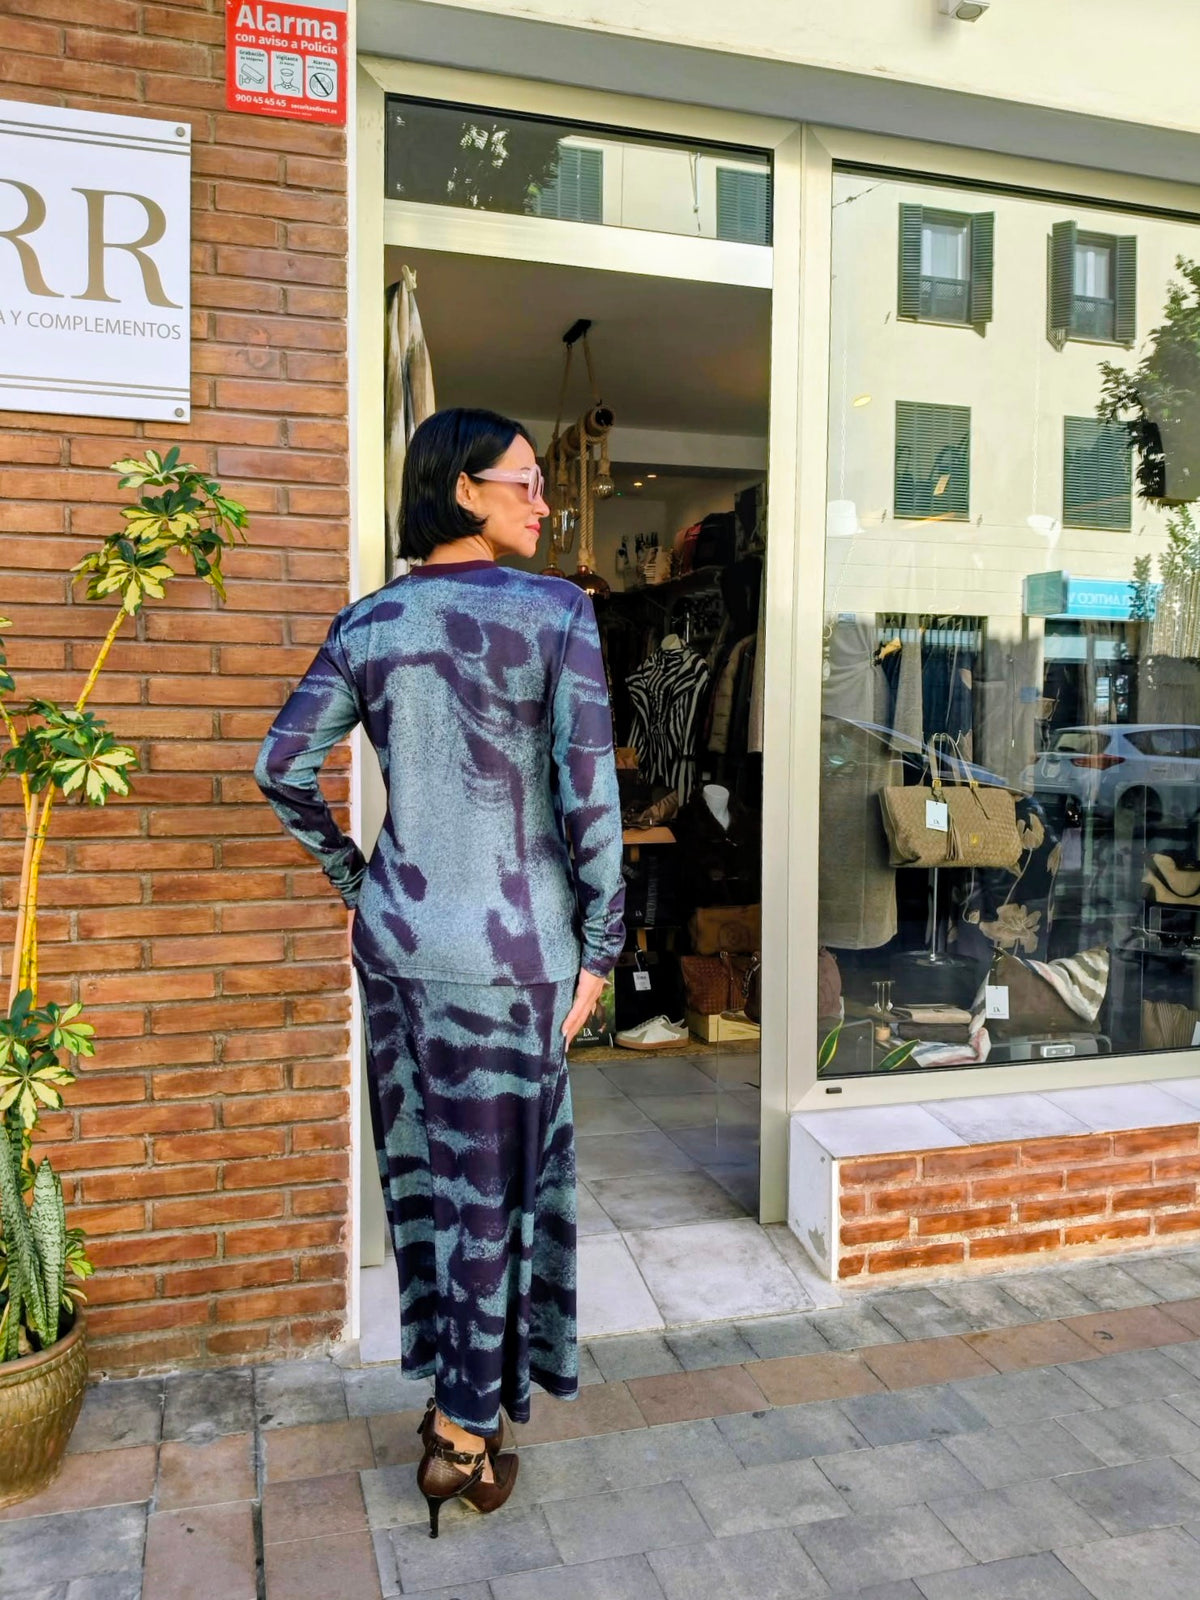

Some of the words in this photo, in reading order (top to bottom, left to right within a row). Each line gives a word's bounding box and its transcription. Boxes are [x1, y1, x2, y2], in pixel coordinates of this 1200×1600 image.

[235, 4, 338, 41] Alarma
[235, 33, 256, 43] con
[258, 35, 288, 48] aviso
[290, 41, 298, 49] a
[300, 40, 338, 55] Policía
[235, 93, 252, 103] 900
[253, 96, 263, 105] 45
[264, 98, 275, 106] 45
[276, 99, 287, 108] 45
[10, 309, 22, 326] Y
[27, 311, 182, 340] COMPLEMENTOS
